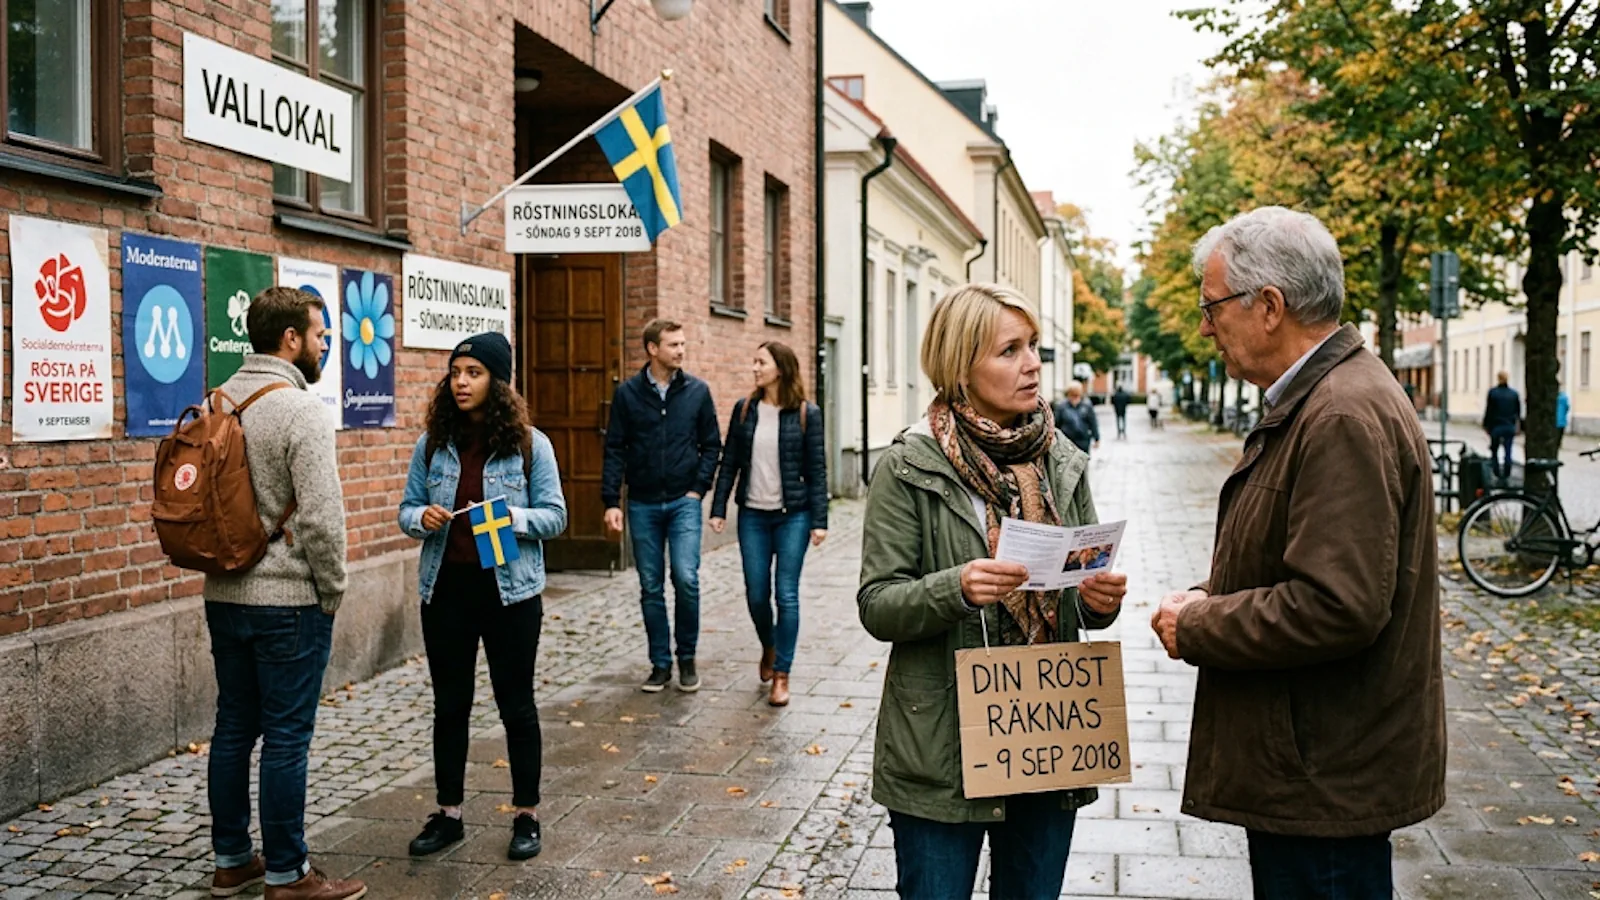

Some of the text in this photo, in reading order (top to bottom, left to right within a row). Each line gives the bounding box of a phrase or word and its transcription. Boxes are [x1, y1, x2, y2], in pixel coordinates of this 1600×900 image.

[201, 67, 341, 153] VALLOKAL
[513, 201, 641, 220] RÖSTNINGSLOKA
[525, 224, 571, 239] SÖNDAG
[574, 227, 581, 239] 9
[584, 226, 612, 239] SEPT
[615, 226, 642, 238] 2018
[408, 270, 507, 310] RÖSTNINGSLOKAL
[420, 308, 456, 332] SÖNDAG
[21, 337, 104, 352] Socialdemokraterna
[31, 358, 96, 378] RÖSTA PÅ
[24, 381, 104, 403] SVERIGE
[38, 417, 44, 425] 9
[972, 652, 1108, 694] DIN RÖST
[987, 698, 1102, 737] RÄKNAS
[997, 748, 1011, 779] 9
[1021, 745, 1063, 776] SEP
[1071, 741, 1121, 772] 2018
